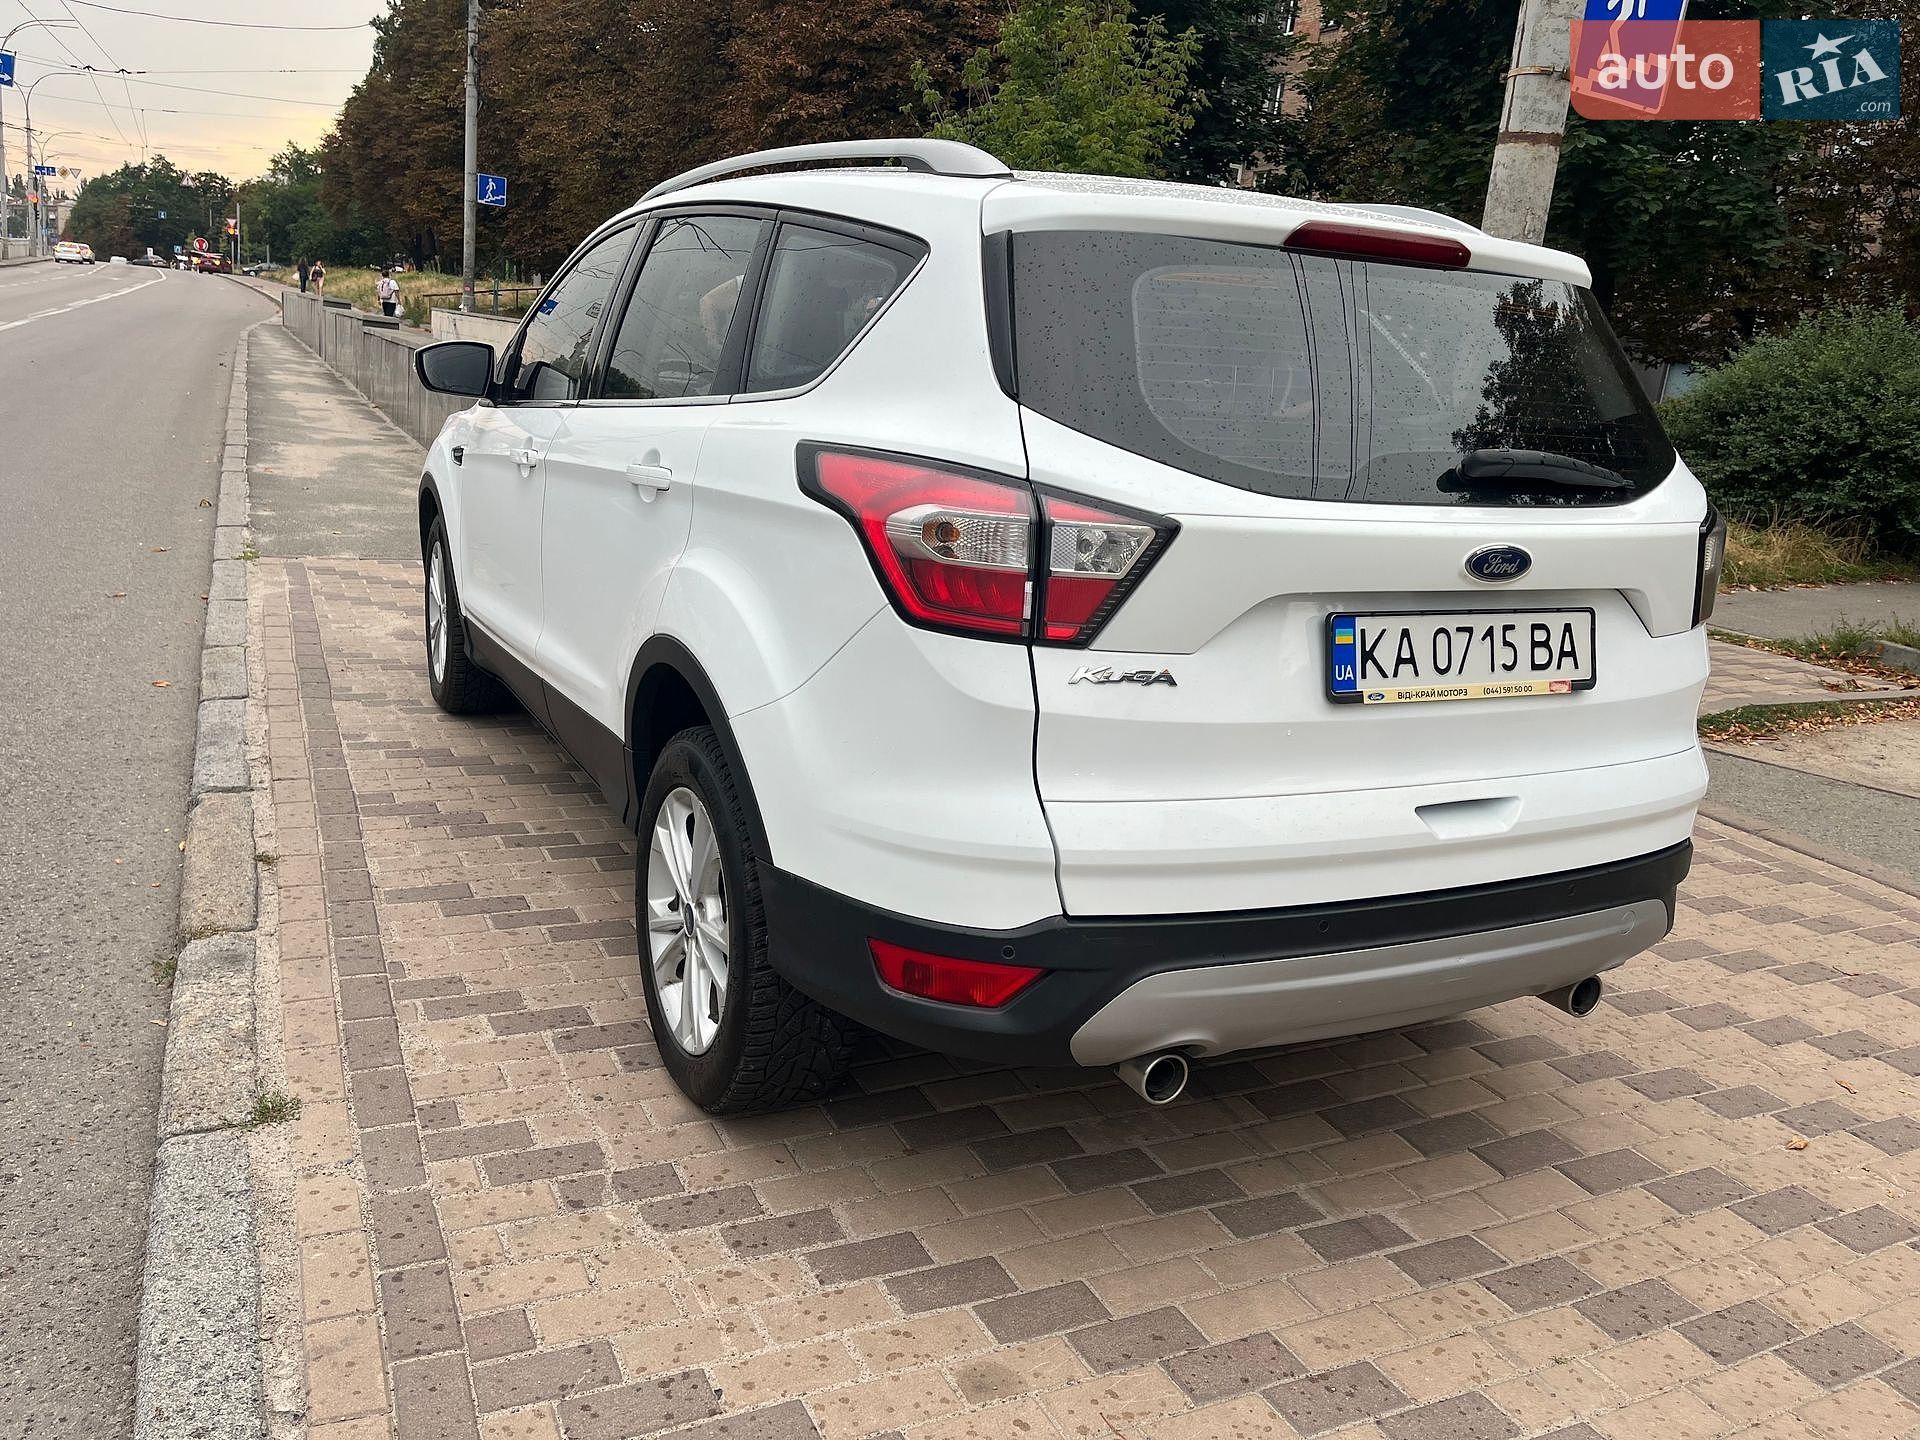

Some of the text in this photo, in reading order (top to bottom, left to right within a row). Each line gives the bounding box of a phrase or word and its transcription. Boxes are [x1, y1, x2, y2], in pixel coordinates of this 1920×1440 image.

[1483, 553, 1520, 574] Ford
[1360, 622, 1580, 680] KA 0715 BA
[1335, 664, 1355, 682] UA
[1483, 686, 1502, 696] (044)
